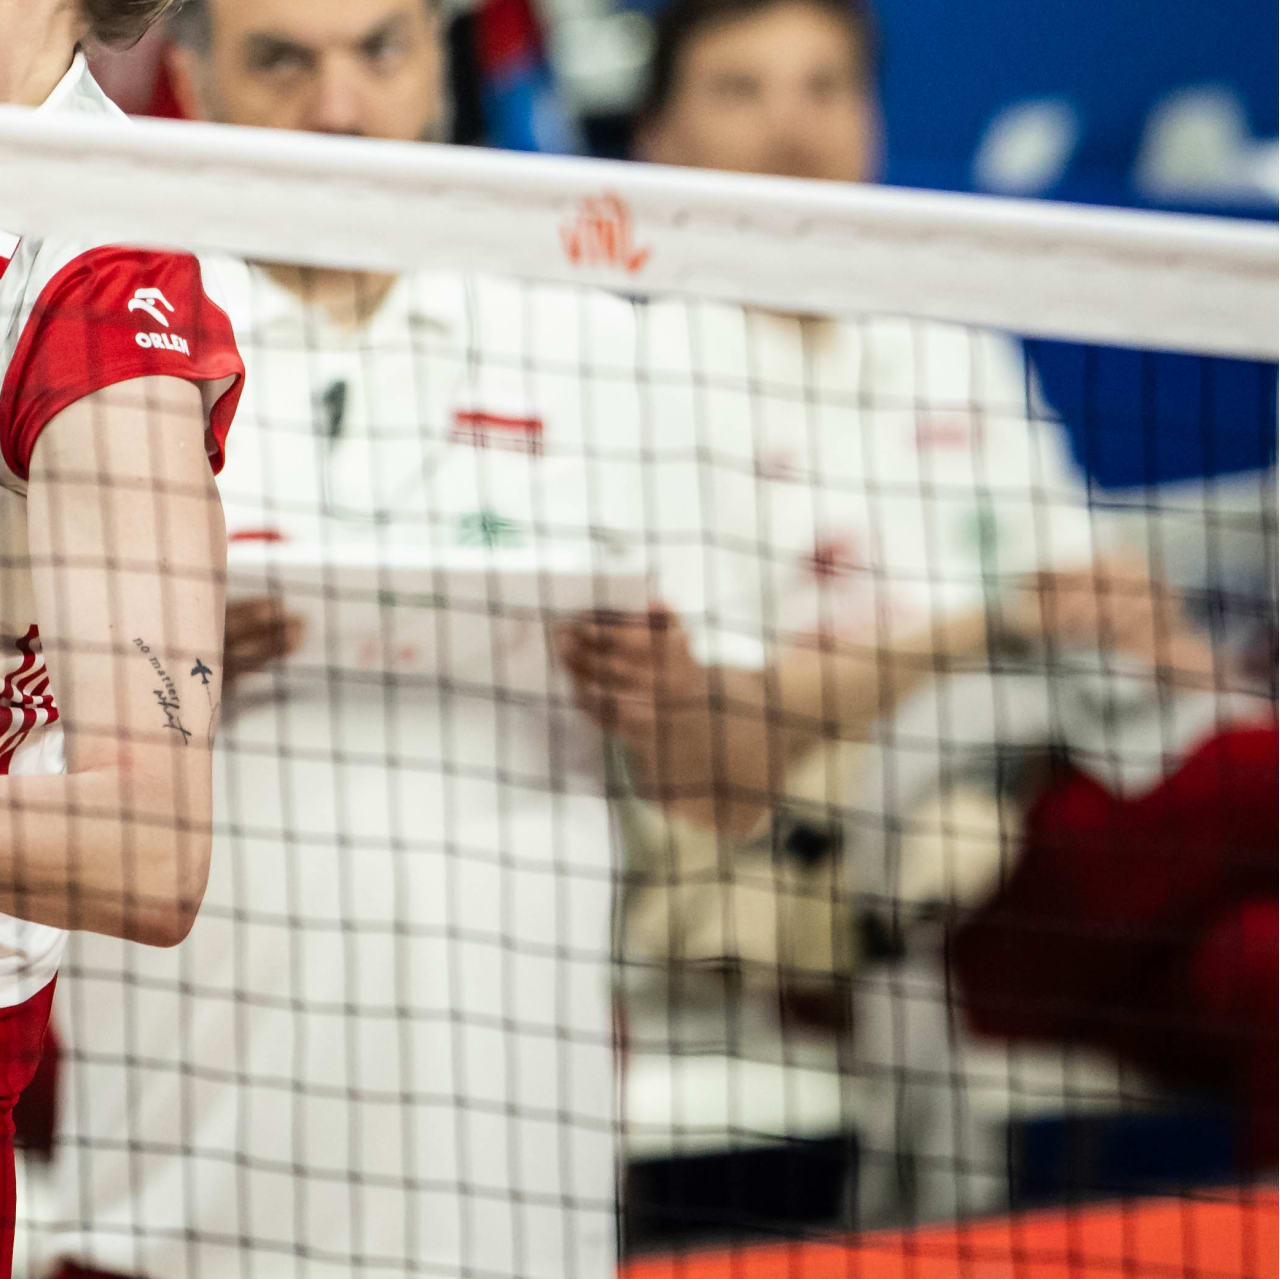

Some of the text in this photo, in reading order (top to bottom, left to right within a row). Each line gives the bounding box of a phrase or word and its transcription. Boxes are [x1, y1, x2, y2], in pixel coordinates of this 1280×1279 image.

[135, 331, 191, 357] ORLEN
[133, 637, 180, 702] no matter
